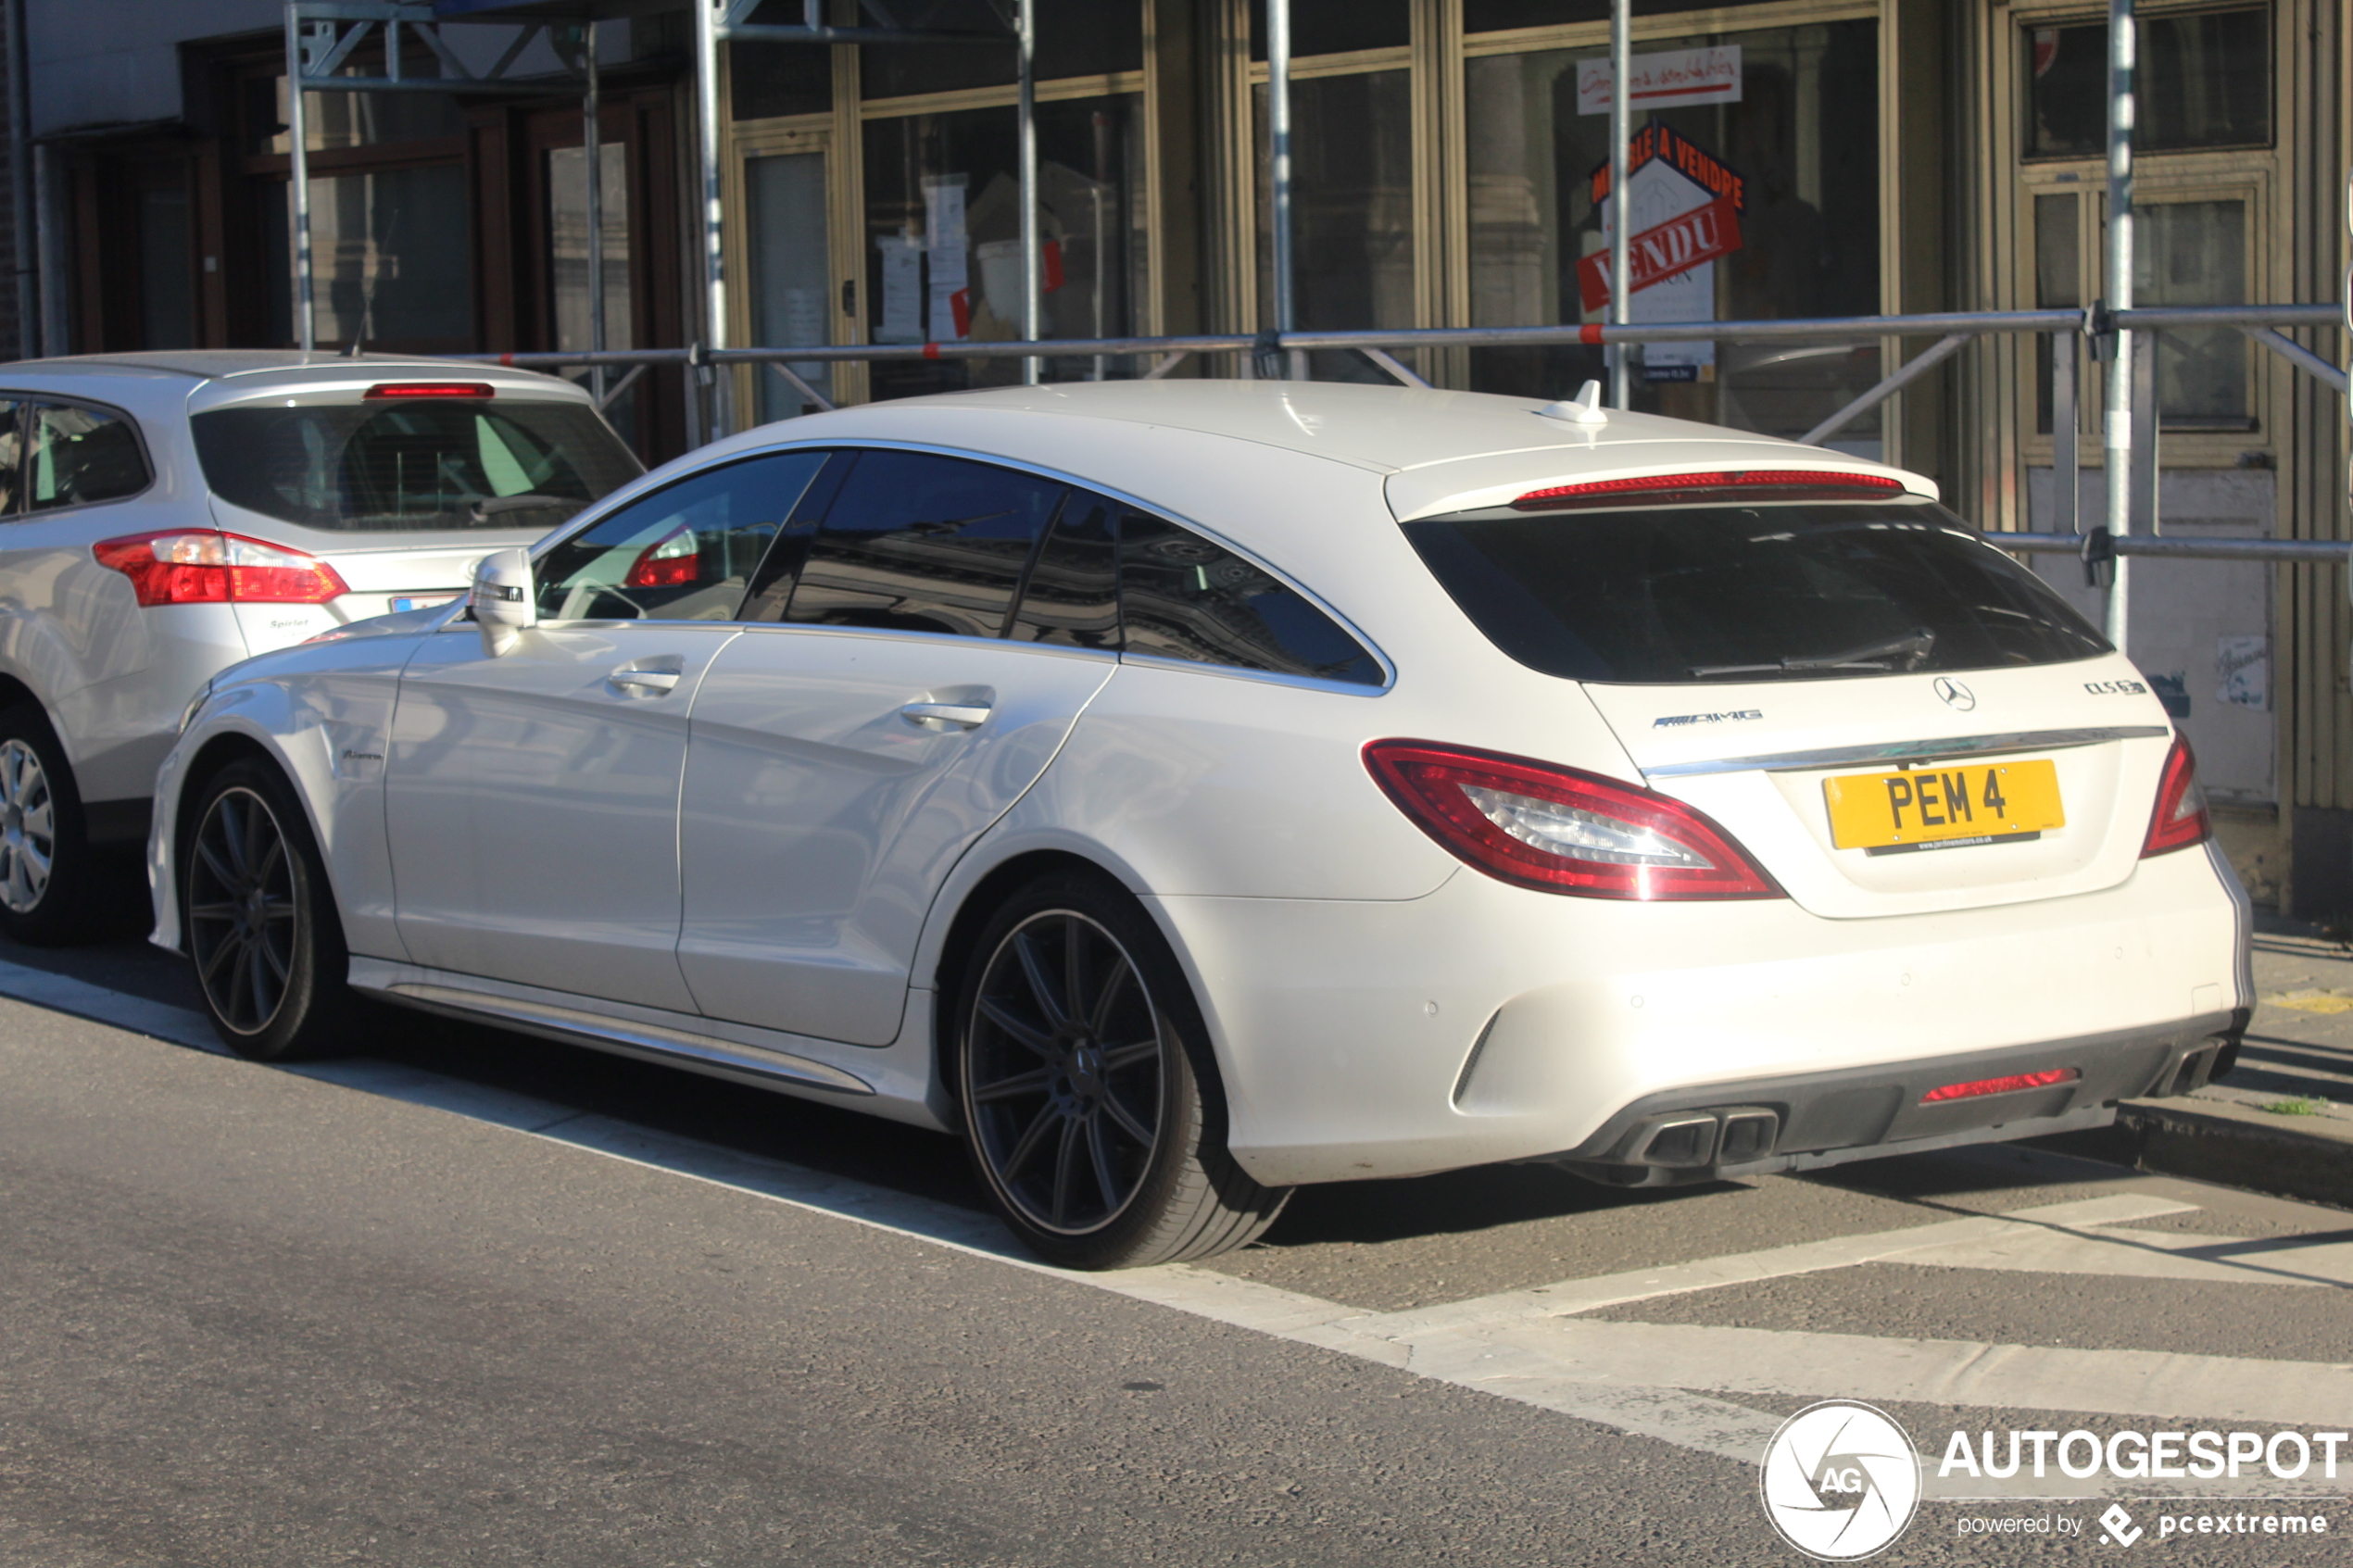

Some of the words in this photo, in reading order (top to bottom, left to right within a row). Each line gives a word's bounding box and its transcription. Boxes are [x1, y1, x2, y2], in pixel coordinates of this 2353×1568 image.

[1658, 126, 1672, 160] A
[1675, 136, 1743, 210] VENDRE
[1886, 771, 1972, 830] PEM
[1982, 769, 2006, 820] 4
